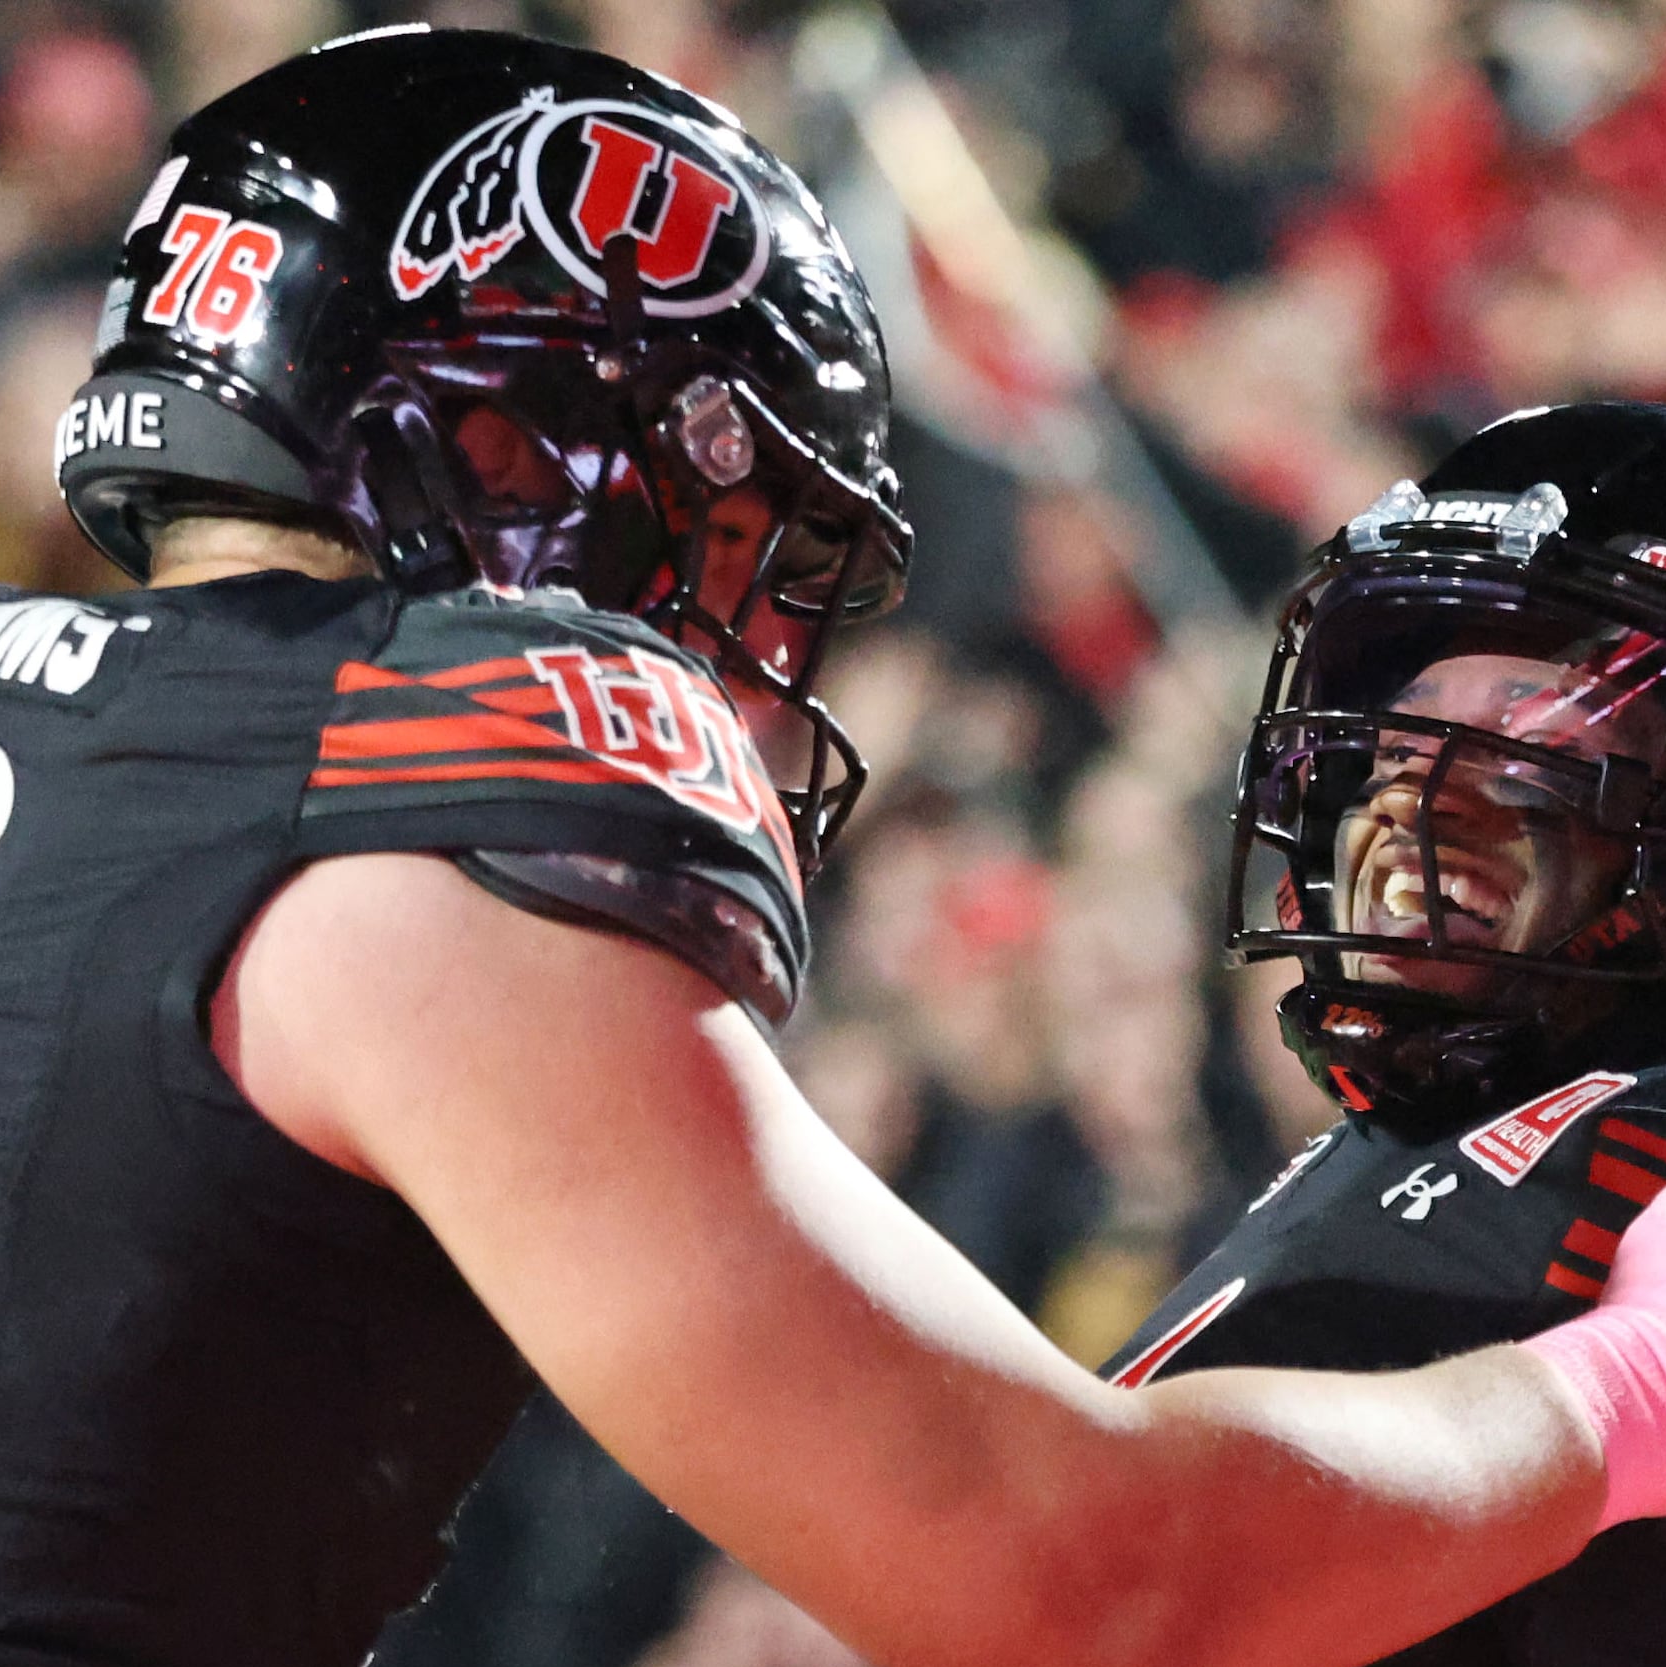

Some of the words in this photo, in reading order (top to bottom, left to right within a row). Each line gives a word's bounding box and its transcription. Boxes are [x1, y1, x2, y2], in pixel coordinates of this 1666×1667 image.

[569, 116, 736, 290] U
[142, 203, 283, 344] 76
[54, 391, 164, 490] EME
[1493, 1117, 1550, 1157] HEALTH
